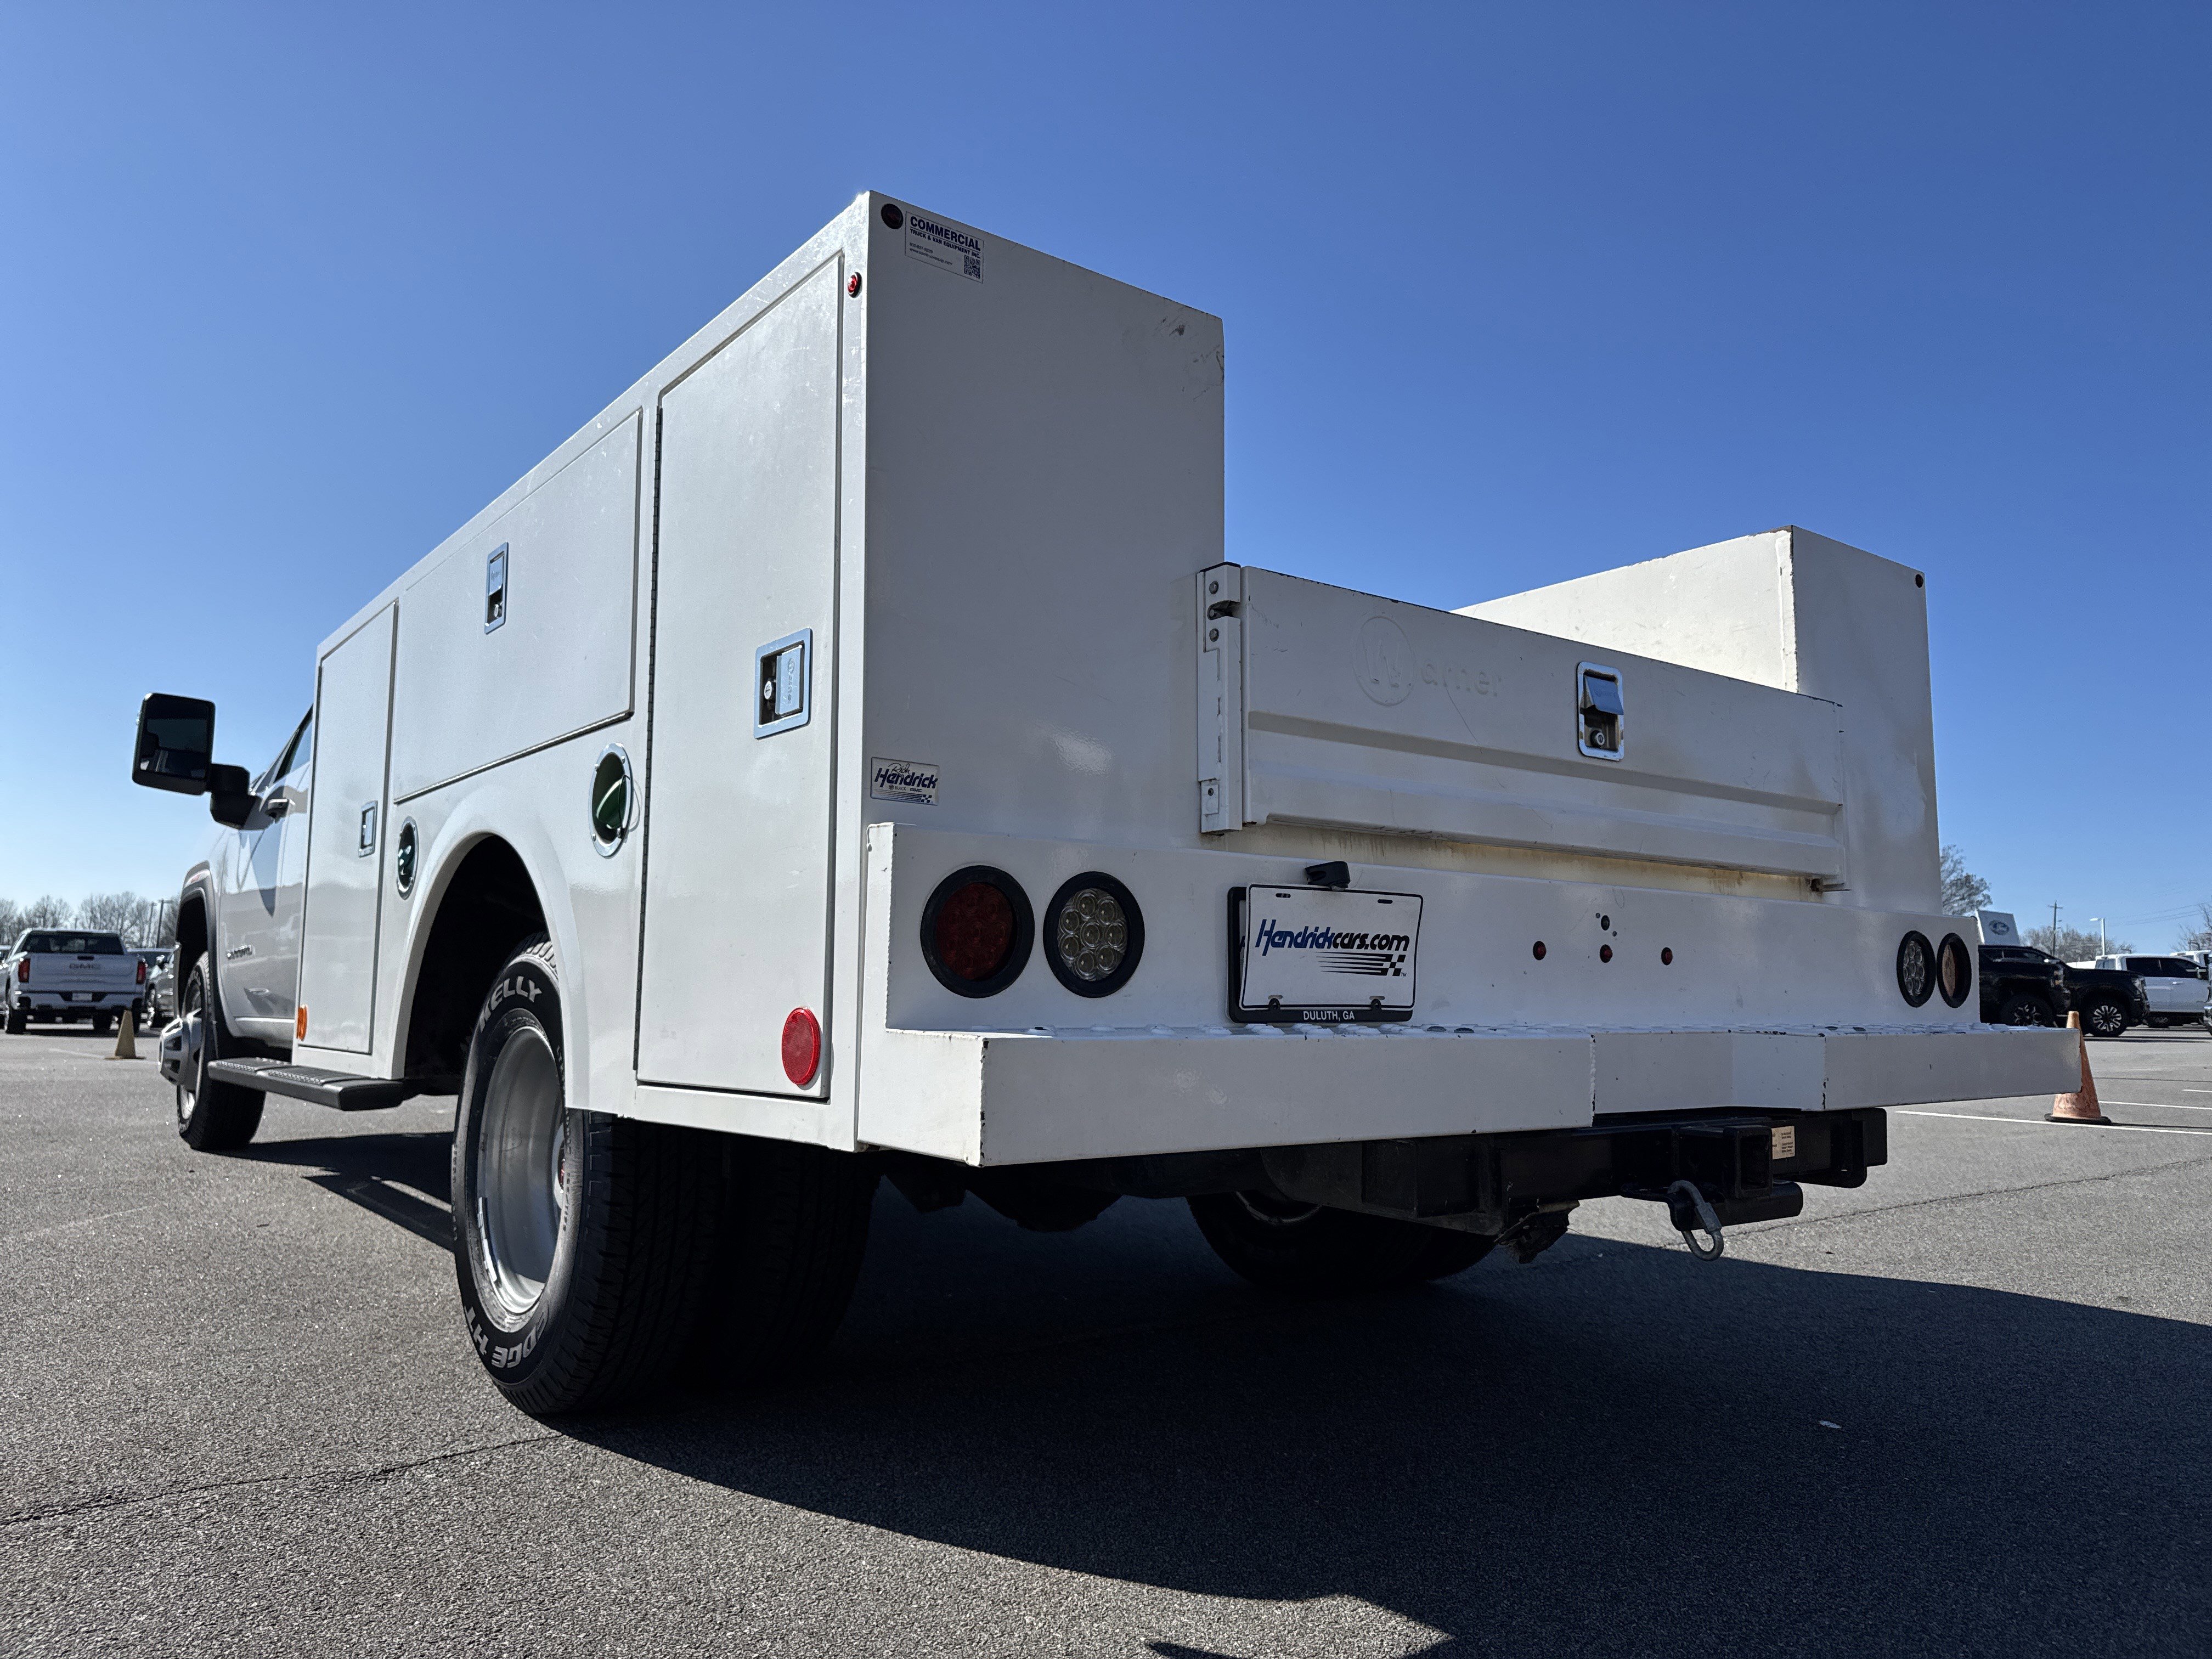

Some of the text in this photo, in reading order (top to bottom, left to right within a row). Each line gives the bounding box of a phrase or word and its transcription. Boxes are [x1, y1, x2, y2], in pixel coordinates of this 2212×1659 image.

[910, 216, 981, 251] COMMERCIAL
[910, 228, 927, 239] TRUCK
[932, 236, 942, 245] VAN
[943, 240, 970, 255] EQUIPMENT
[971, 251, 981, 259] INC.
[874, 768, 939, 789] Hendrick
[888, 763, 910, 777] Rick
[1255, 918, 1410, 956] Hendrickcars.com
[479, 975, 542, 1034] KELLY
[1304, 1011, 1355, 1022] DULUTH, GA
